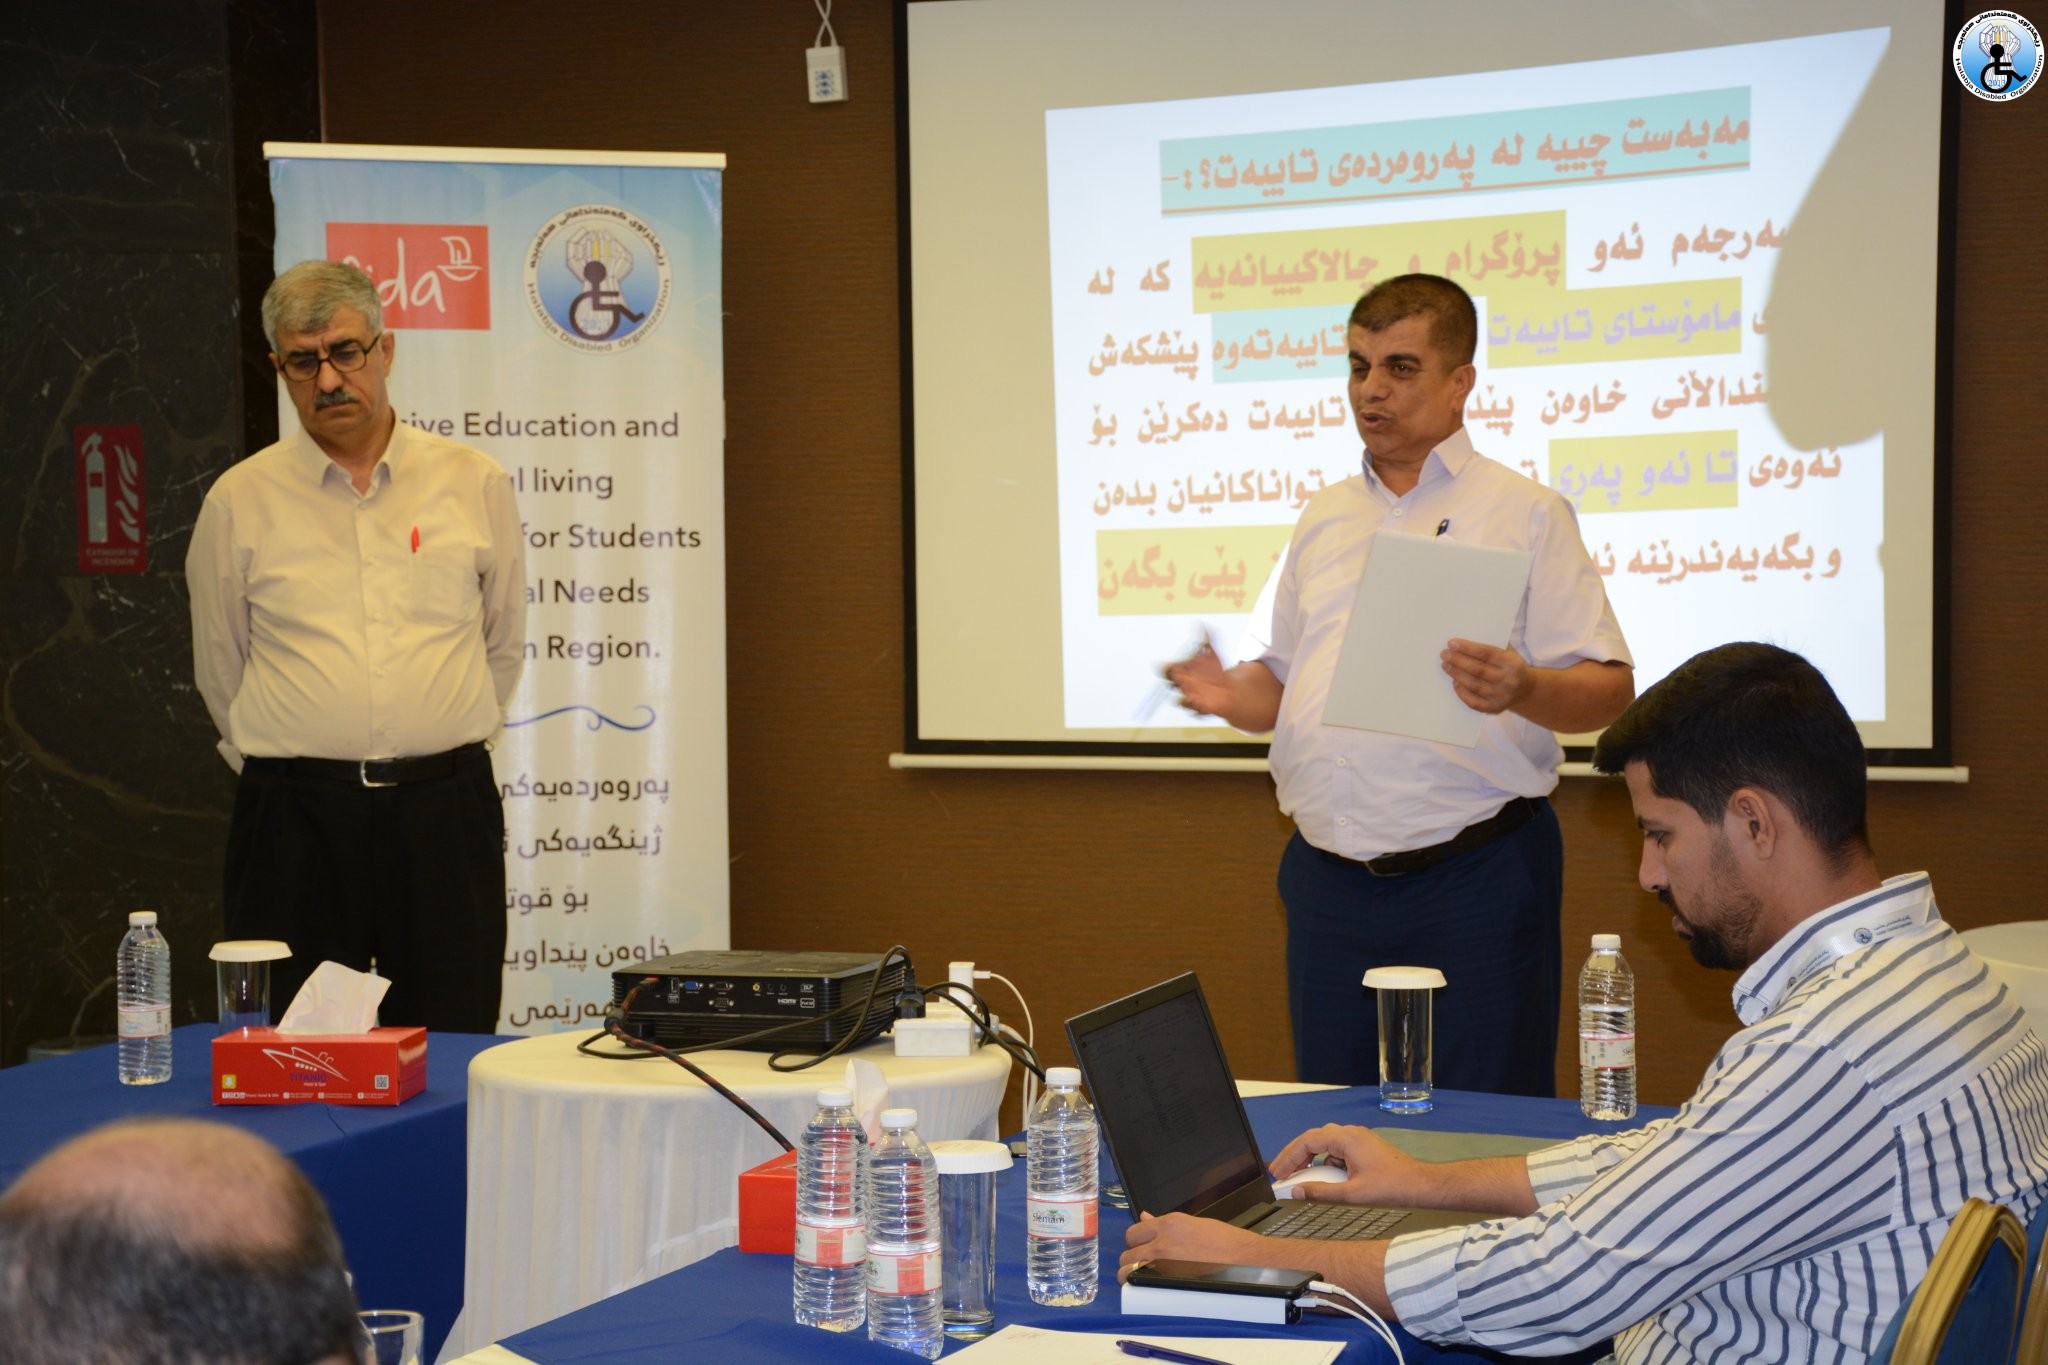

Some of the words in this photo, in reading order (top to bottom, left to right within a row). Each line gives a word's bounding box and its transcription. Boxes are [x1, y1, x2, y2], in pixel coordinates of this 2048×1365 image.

[1491, 132, 1524, 166] لە
[1087, 265, 1115, 294] لە
[1139, 259, 1171, 292] کە
[527, 282, 558, 335] Halabja
[560, 331, 612, 352] Disabled
[618, 279, 670, 348] Organization
[464, 411, 616, 438] Education
[624, 411, 680, 438] and
[1705, 449, 1738, 483] تا
[534, 467, 614, 500] living
[568, 523, 702, 548] Students
[553, 577, 650, 604] Needs
[548, 634, 661, 665] Region.
[289, 1072, 328, 1082] TITANIC
